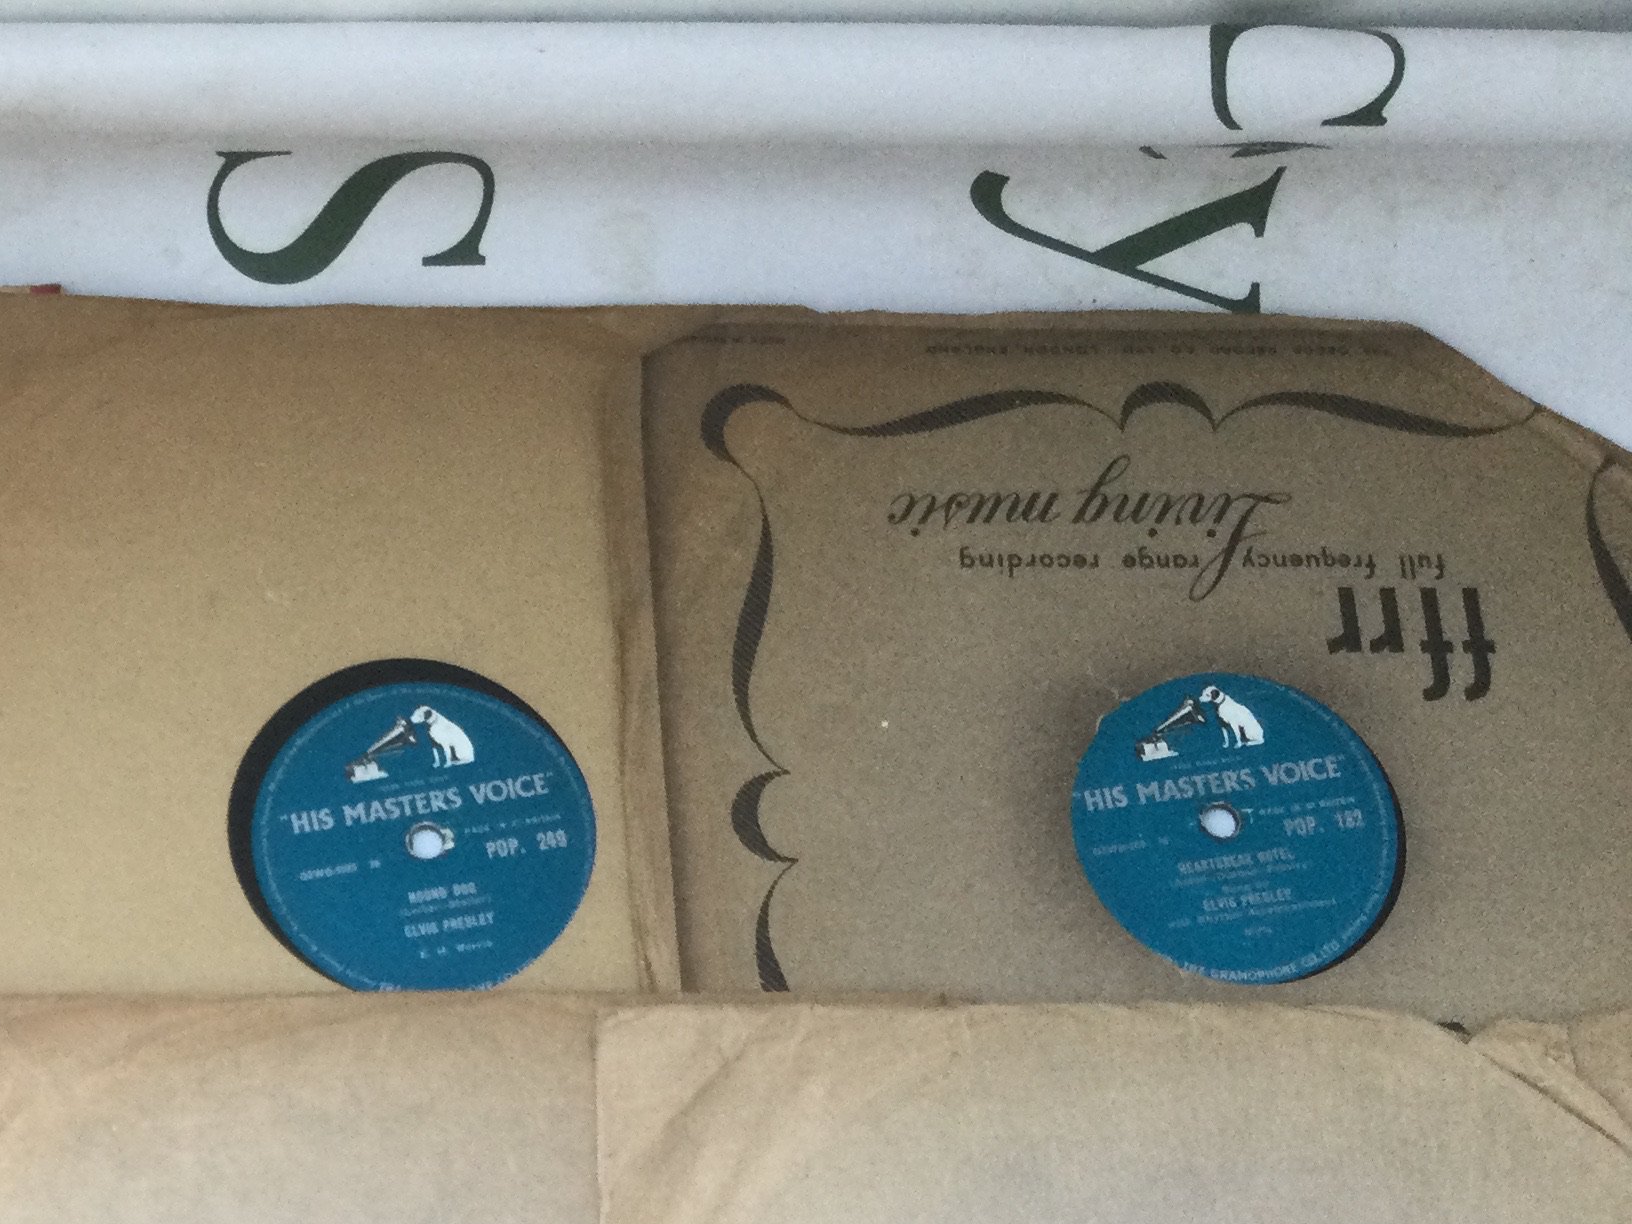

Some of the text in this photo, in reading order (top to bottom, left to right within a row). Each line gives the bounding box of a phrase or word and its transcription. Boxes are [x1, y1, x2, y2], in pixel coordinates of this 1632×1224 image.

[886, 454, 1293, 601] Living music
[959, 546, 1446, 582] full frequency range recording
[1328, 586, 1497, 702] ffrr
